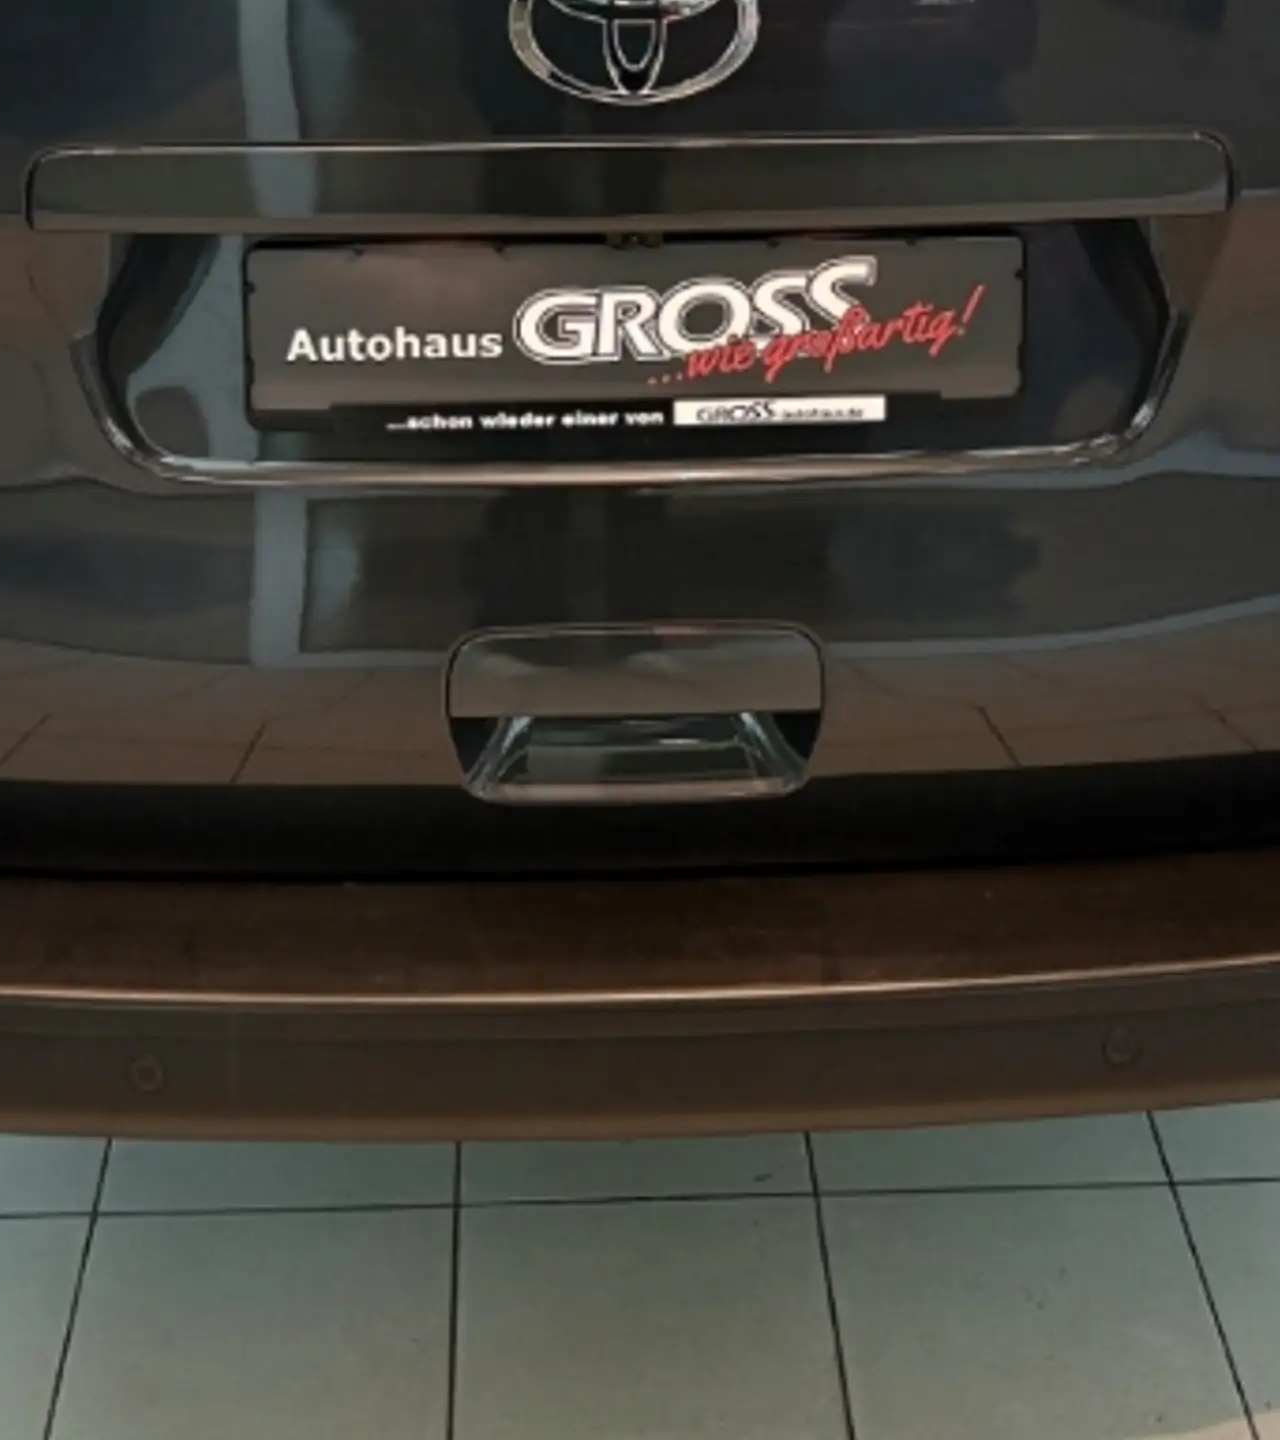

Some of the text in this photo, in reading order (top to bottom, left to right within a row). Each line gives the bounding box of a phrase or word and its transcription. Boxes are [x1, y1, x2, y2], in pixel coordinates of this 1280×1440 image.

[286, 255, 877, 365] Autohaus GROSS
[624, 411, 664, 426] von
